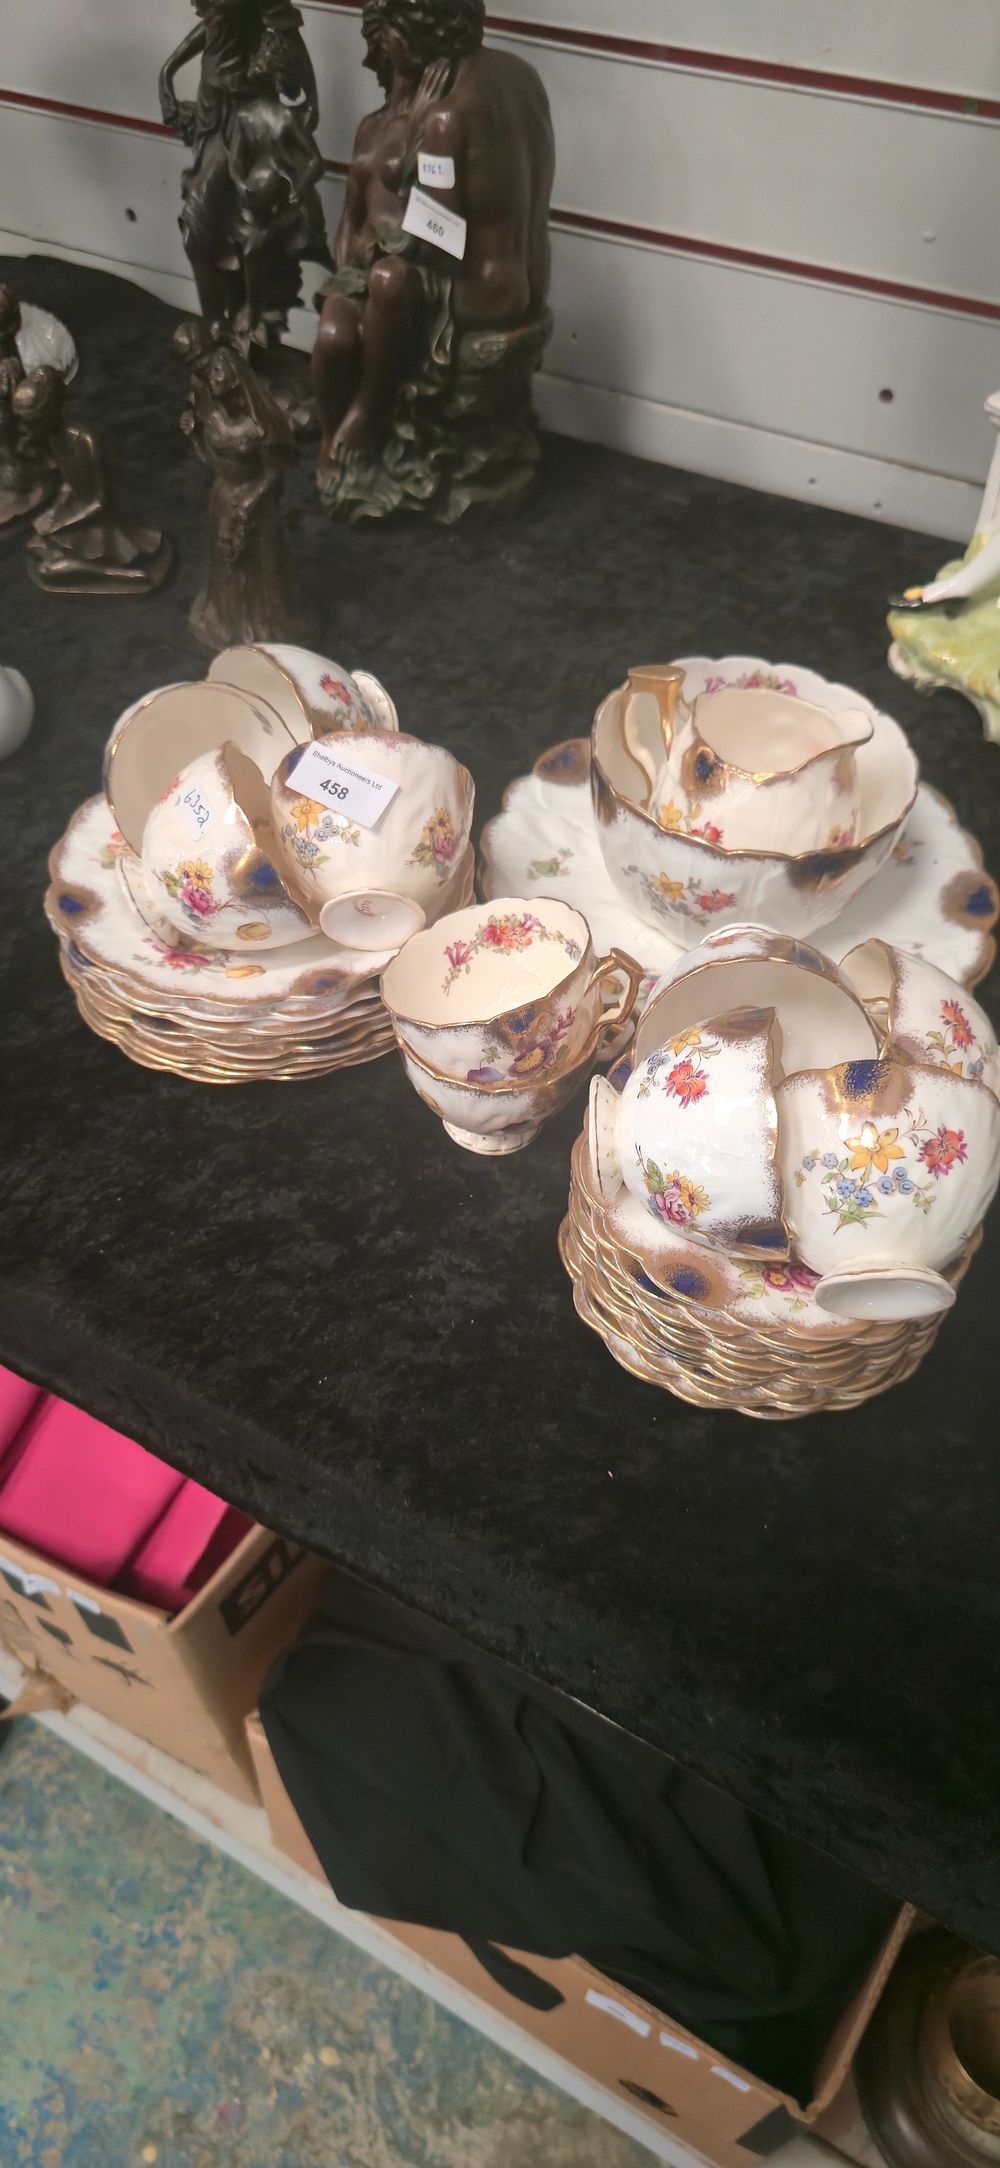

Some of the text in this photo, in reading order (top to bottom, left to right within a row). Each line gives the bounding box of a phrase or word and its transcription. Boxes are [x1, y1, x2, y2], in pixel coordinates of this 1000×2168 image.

[313, 750, 383, 791] Shelbys Auctioneers Ltd
[319, 779, 349, 800] 458
